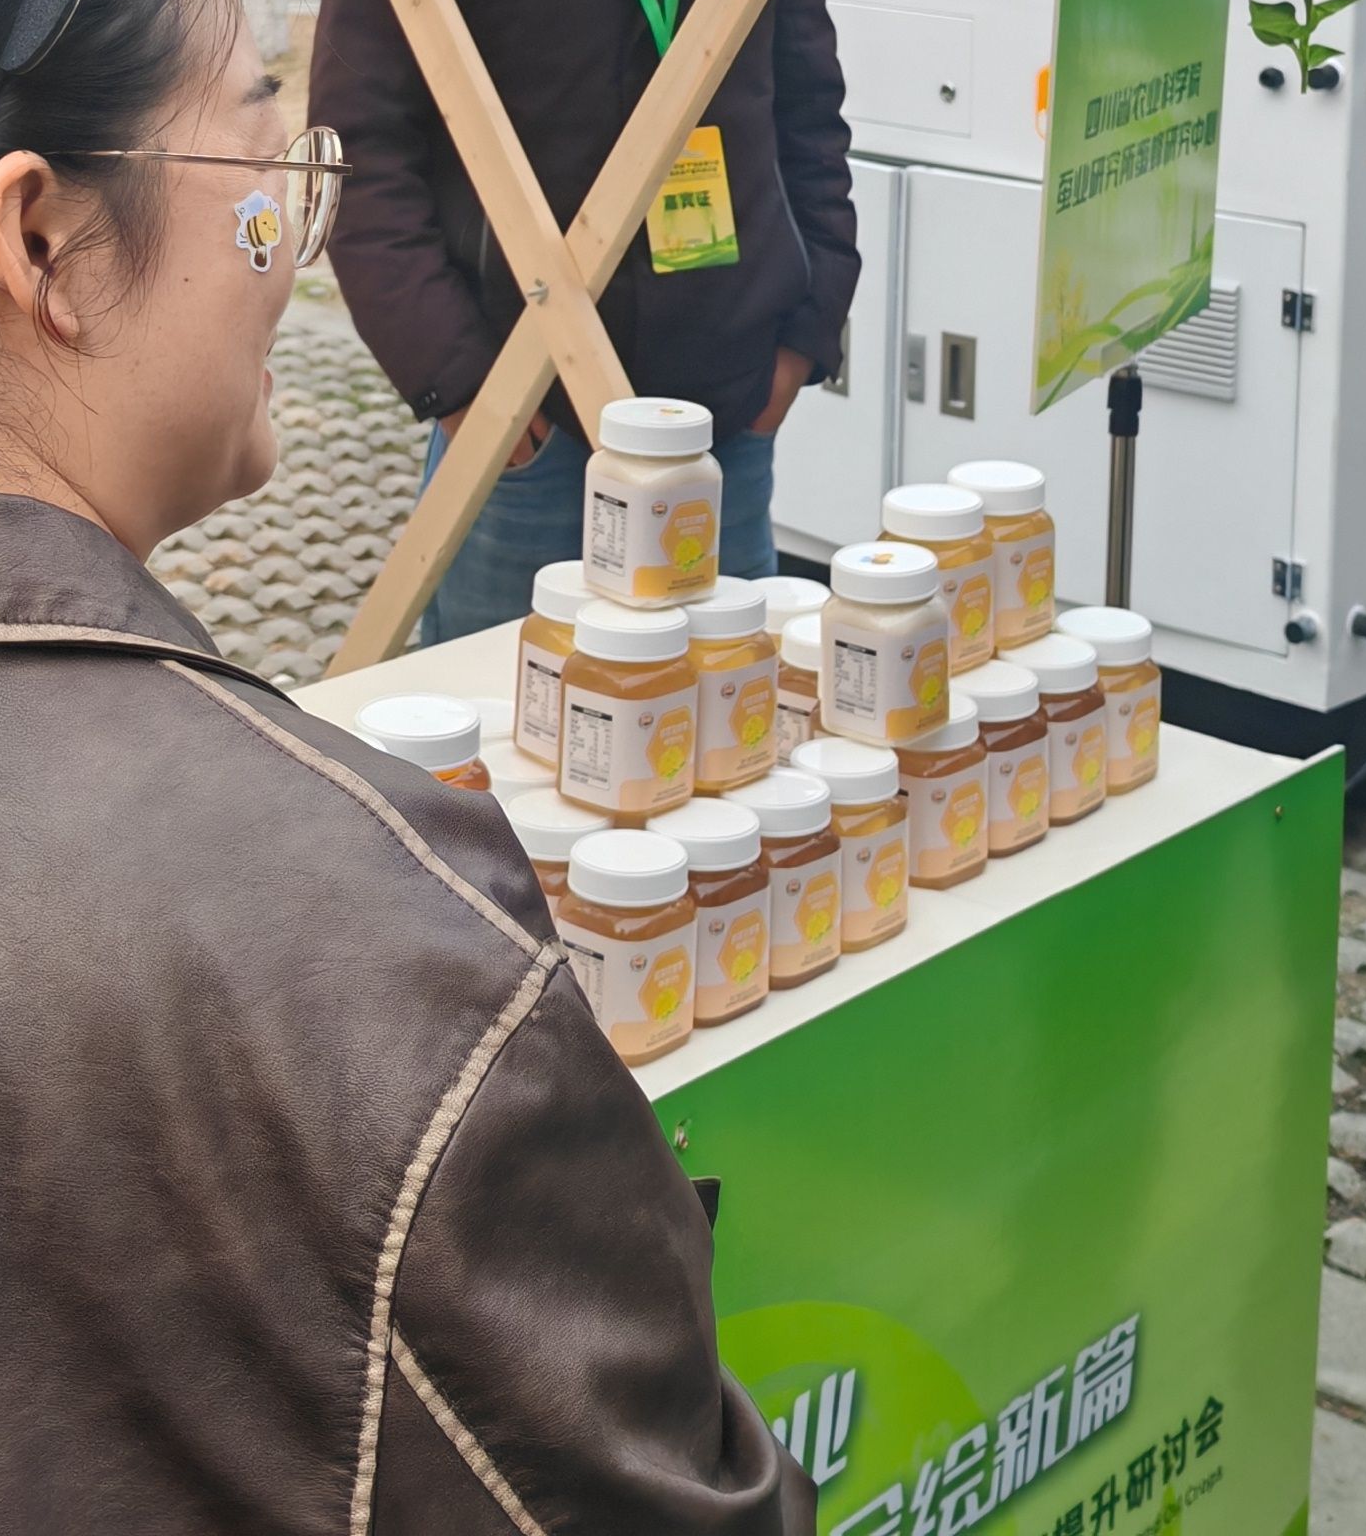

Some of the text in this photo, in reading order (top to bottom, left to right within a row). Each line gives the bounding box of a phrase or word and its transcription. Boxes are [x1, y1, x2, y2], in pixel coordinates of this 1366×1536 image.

[1042, 1395, 1224, 1536] 提升研讨会
